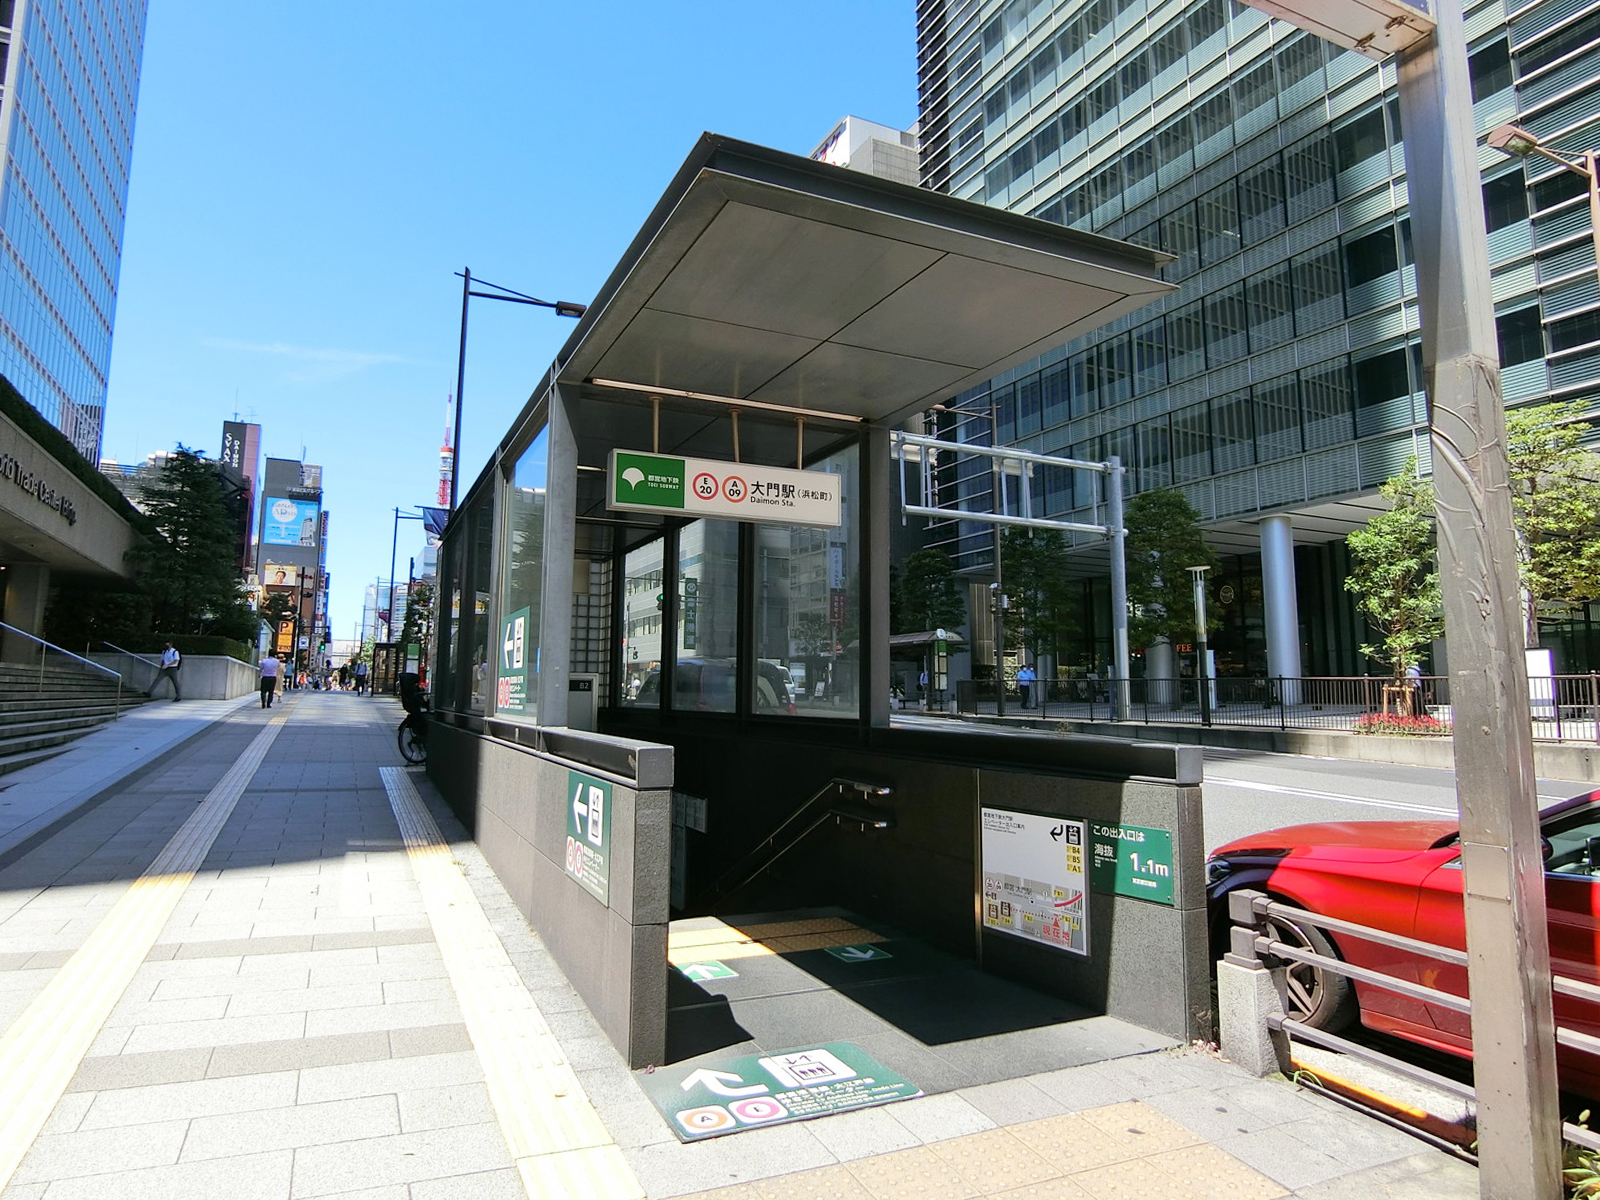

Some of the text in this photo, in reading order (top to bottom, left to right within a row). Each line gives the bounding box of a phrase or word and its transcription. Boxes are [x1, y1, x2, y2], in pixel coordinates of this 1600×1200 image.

[223, 432, 232, 462] SVAX
[14, 460, 38, 495] Trade
[38, 480, 61, 512] Center
[648, 475, 679, 484] 都営地下鉄
[700, 486, 712, 494] 20
[728, 488, 741, 497] 09
[750, 496, 796, 507] Daimon Sta.
[280, 622, 289, 632] P
[1093, 825, 1145, 842] この出入口は
[1094, 843, 1114, 857] 海抜
[1130, 852, 1169, 876] 1.1m
[1043, 924, 1070, 941] 現在地
